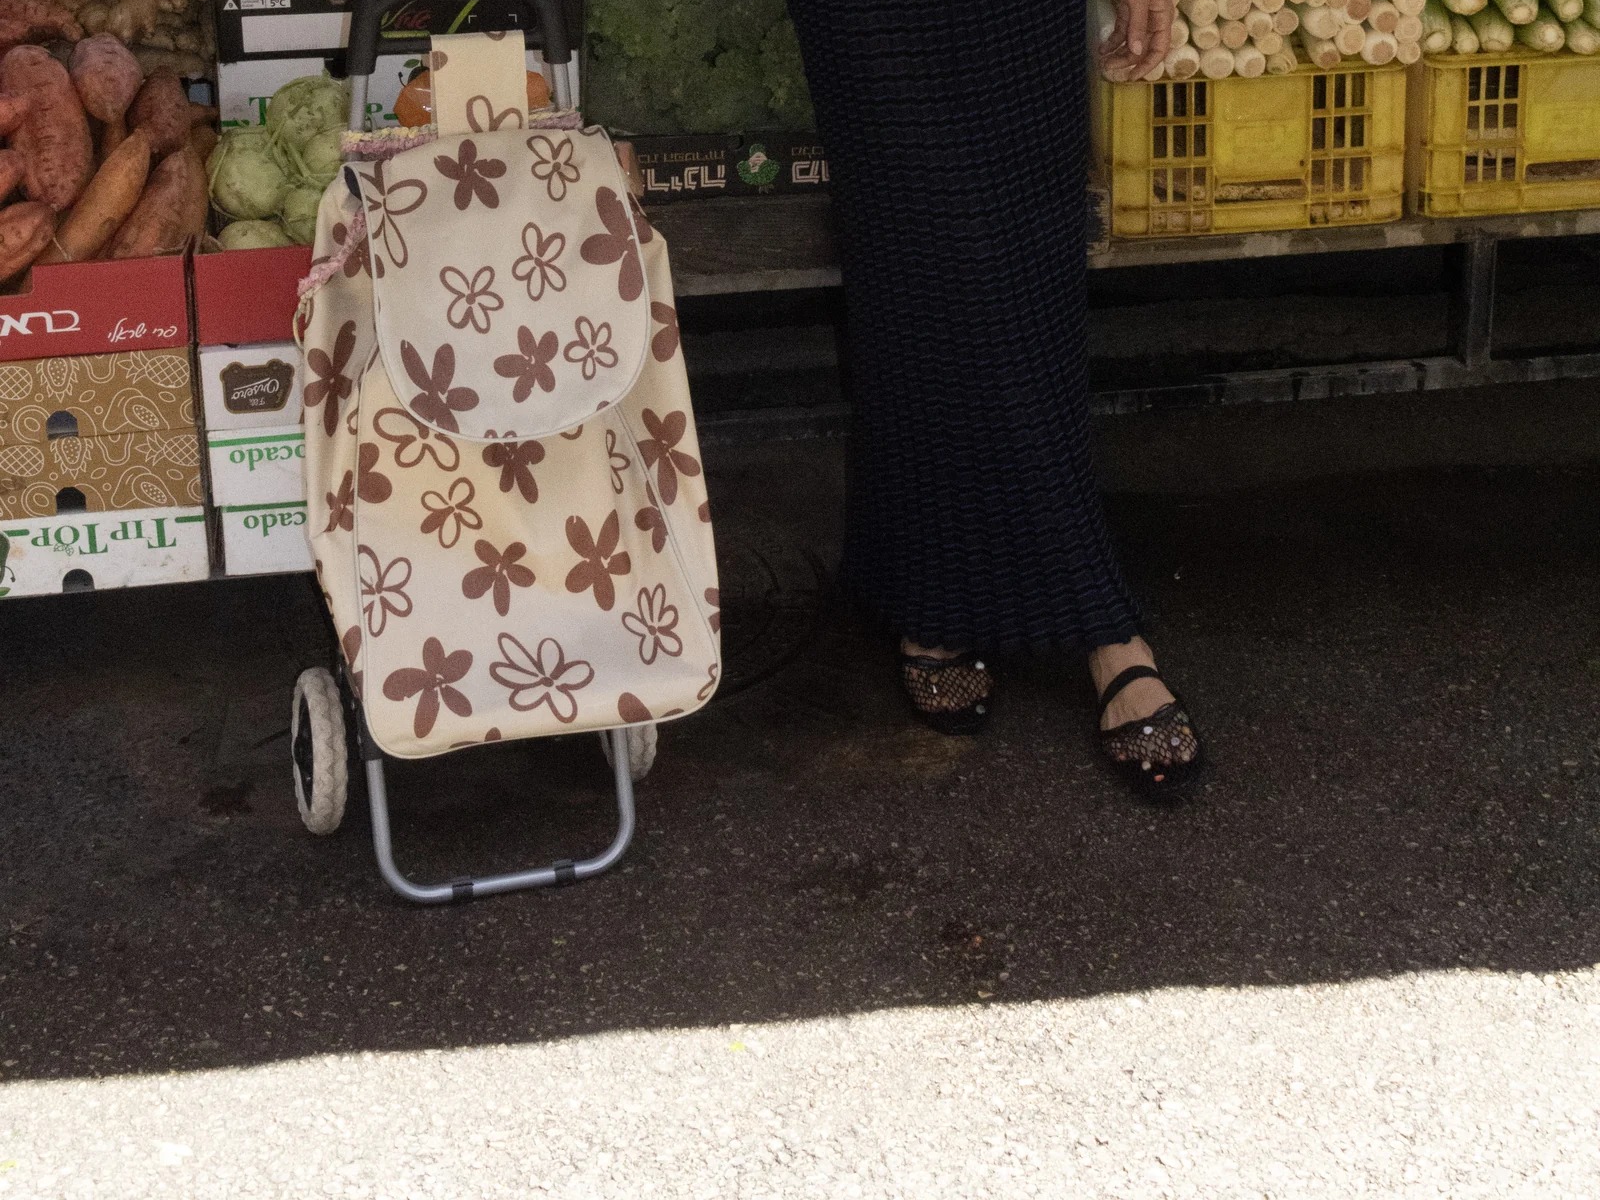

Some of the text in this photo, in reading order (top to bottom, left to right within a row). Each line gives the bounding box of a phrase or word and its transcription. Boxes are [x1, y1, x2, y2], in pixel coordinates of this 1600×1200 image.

[642, 164, 727, 193] רינה
[0, 309, 81, 337] ברא
[107, 317, 147, 343] ישראלי
[230, 378, 280, 402] Orsero
[30, 517, 177, 556] TIP TOP
[243, 511, 307, 537] cado
